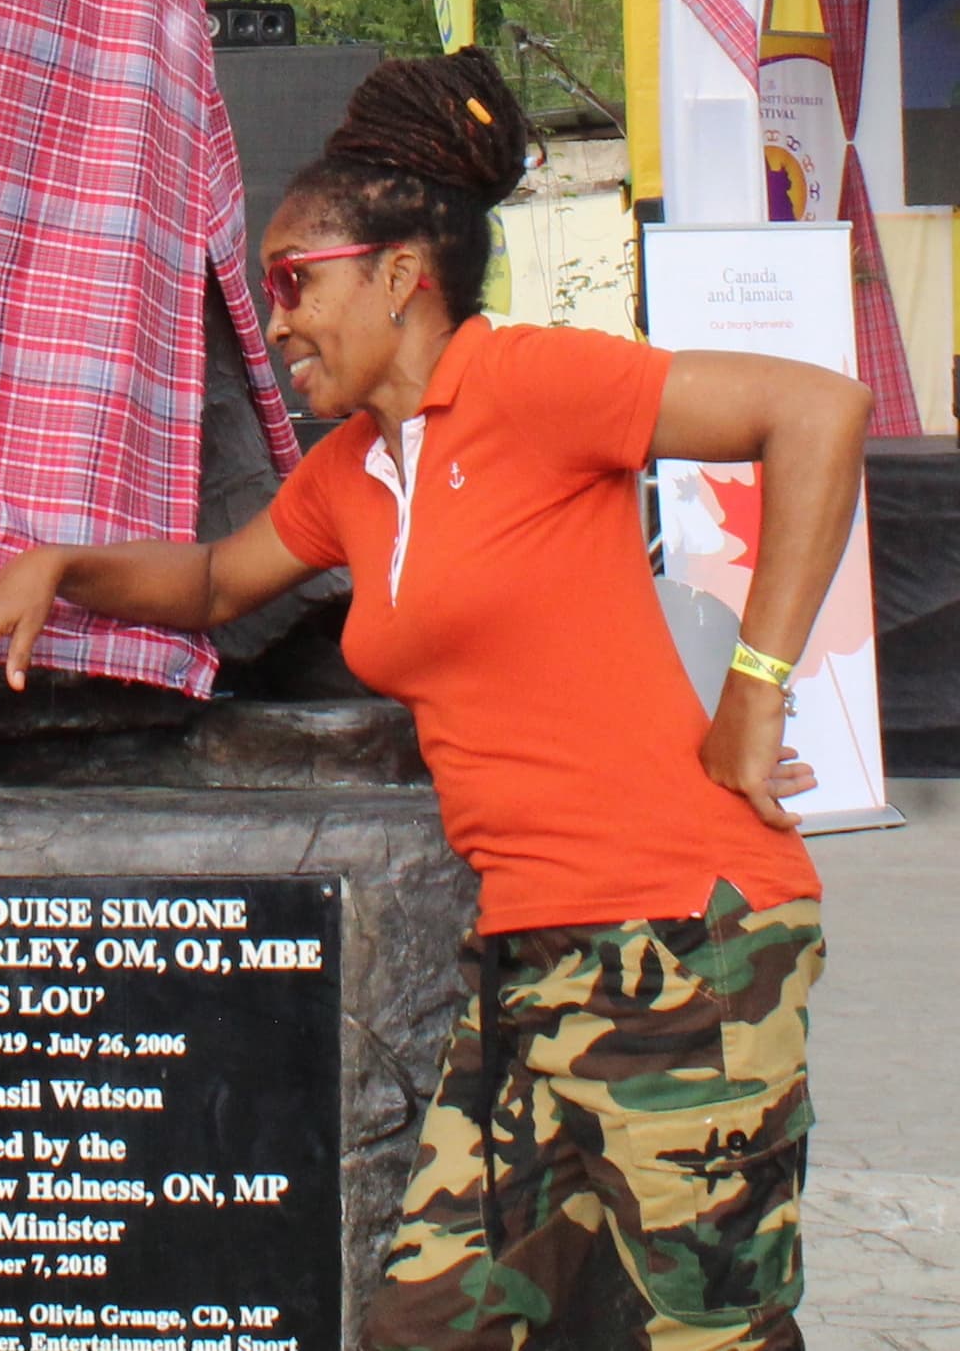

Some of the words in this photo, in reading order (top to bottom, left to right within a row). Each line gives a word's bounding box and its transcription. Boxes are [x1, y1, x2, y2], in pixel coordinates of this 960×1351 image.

[759, 108, 796, 120] STIVAL
[722, 266, 777, 284] Canada
[707, 286, 736, 303] and
[738, 286, 793, 305] Jamaica
[101, 898, 248, 930] SIMONE
[94, 939, 167, 974] OM,
[174, 939, 232, 975] OJ,
[238, 939, 323, 969] MBE
[46, 1033, 93, 1059] July
[97, 1033, 131, 1058] 26,
[135, 1034, 186, 1055] 2006
[49, 1080, 164, 1109] Watson
[33, 1131, 70, 1166] by
[78, 1132, 127, 1160] the
[26, 1172, 155, 1207] Holness,
[162, 1173, 226, 1208] ON,
[233, 1174, 289, 1202] MP
[30, 1254, 52, 1279] 7,
[56, 1255, 107, 1277] 2018
[29, 1304, 96, 1326] Olivia
[100, 1305, 187, 1331] Grange,
[191, 1306, 235, 1331] CD,
[239, 1306, 280, 1328] MP
[29, 1332, 187, 1351] Entertainment
[191, 1334, 233, 1351] and
